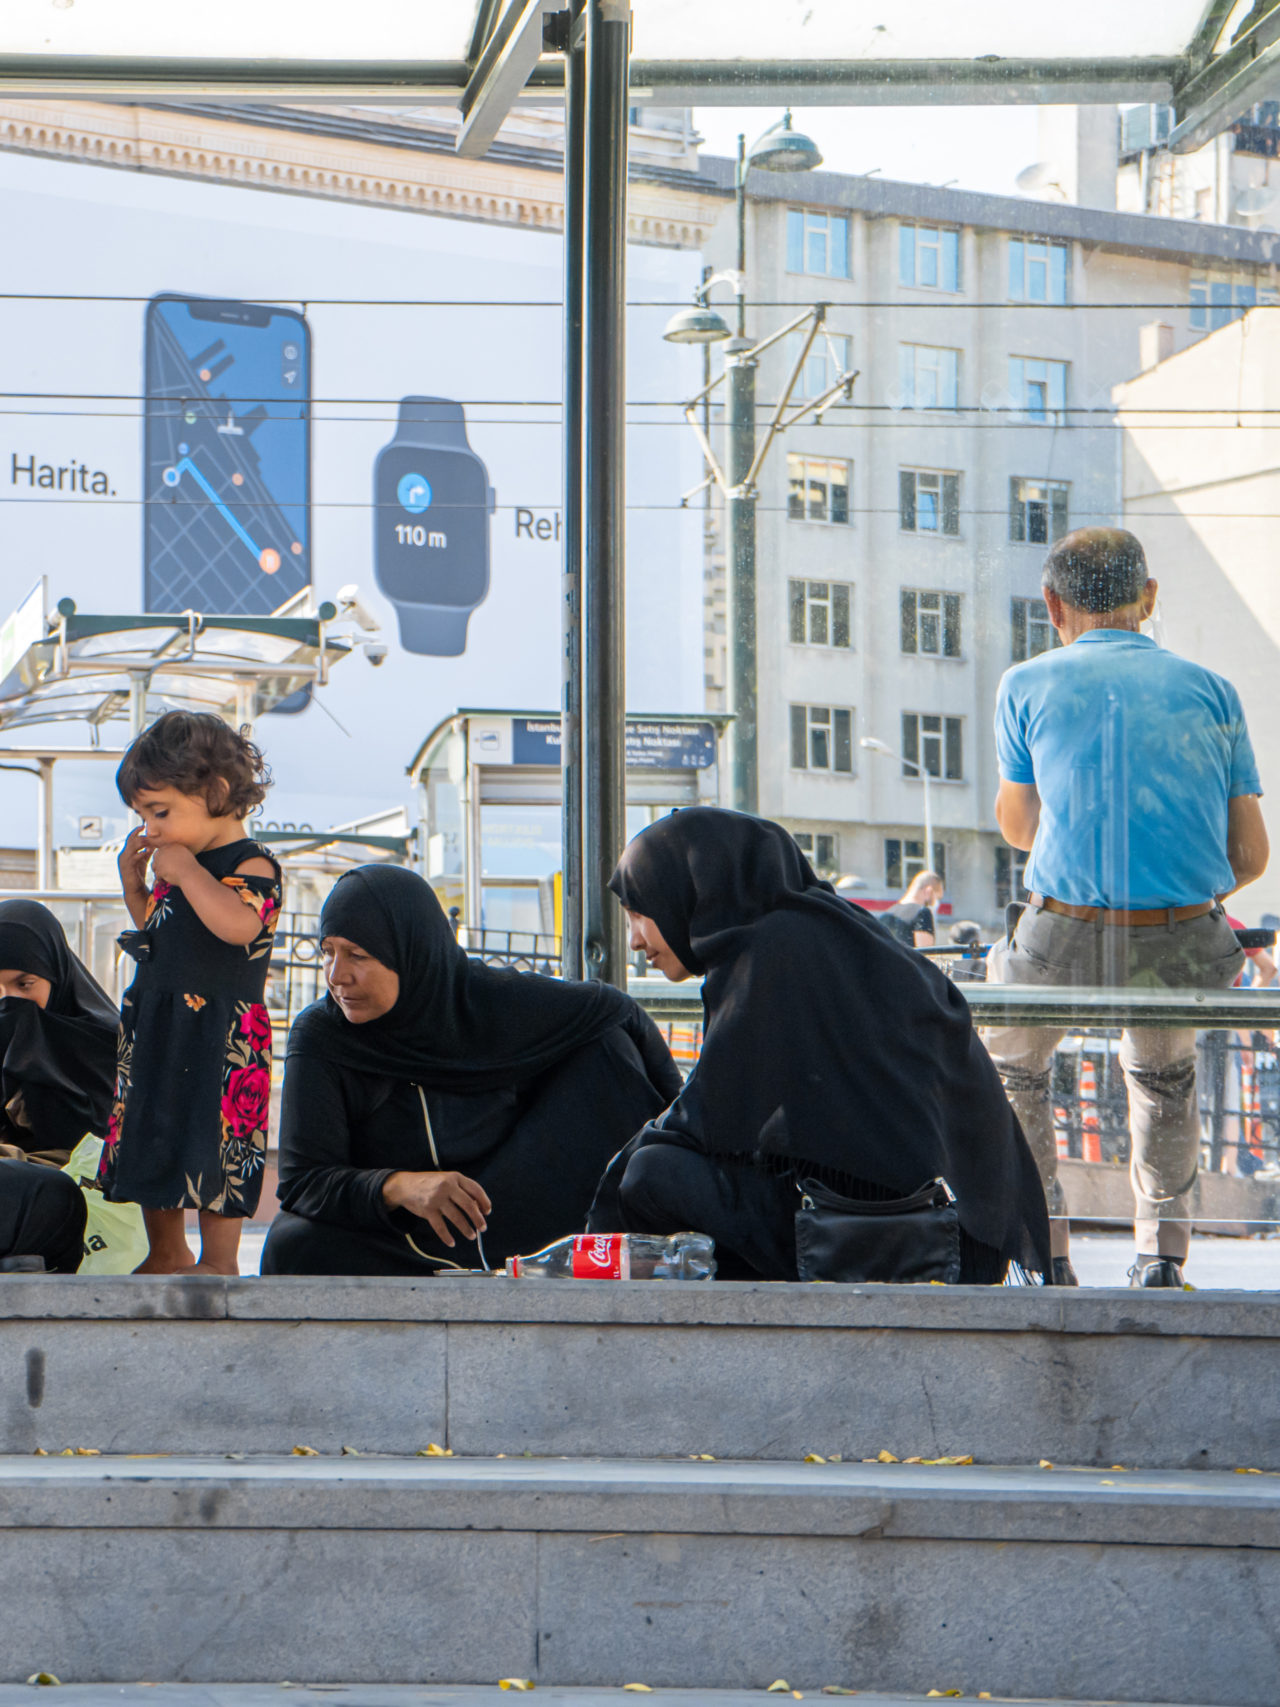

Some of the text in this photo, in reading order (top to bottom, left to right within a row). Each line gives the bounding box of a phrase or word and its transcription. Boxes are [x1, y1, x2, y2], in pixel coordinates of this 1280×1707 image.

[11, 453, 117, 496] Harita.
[395, 524, 448, 549] 110 m
